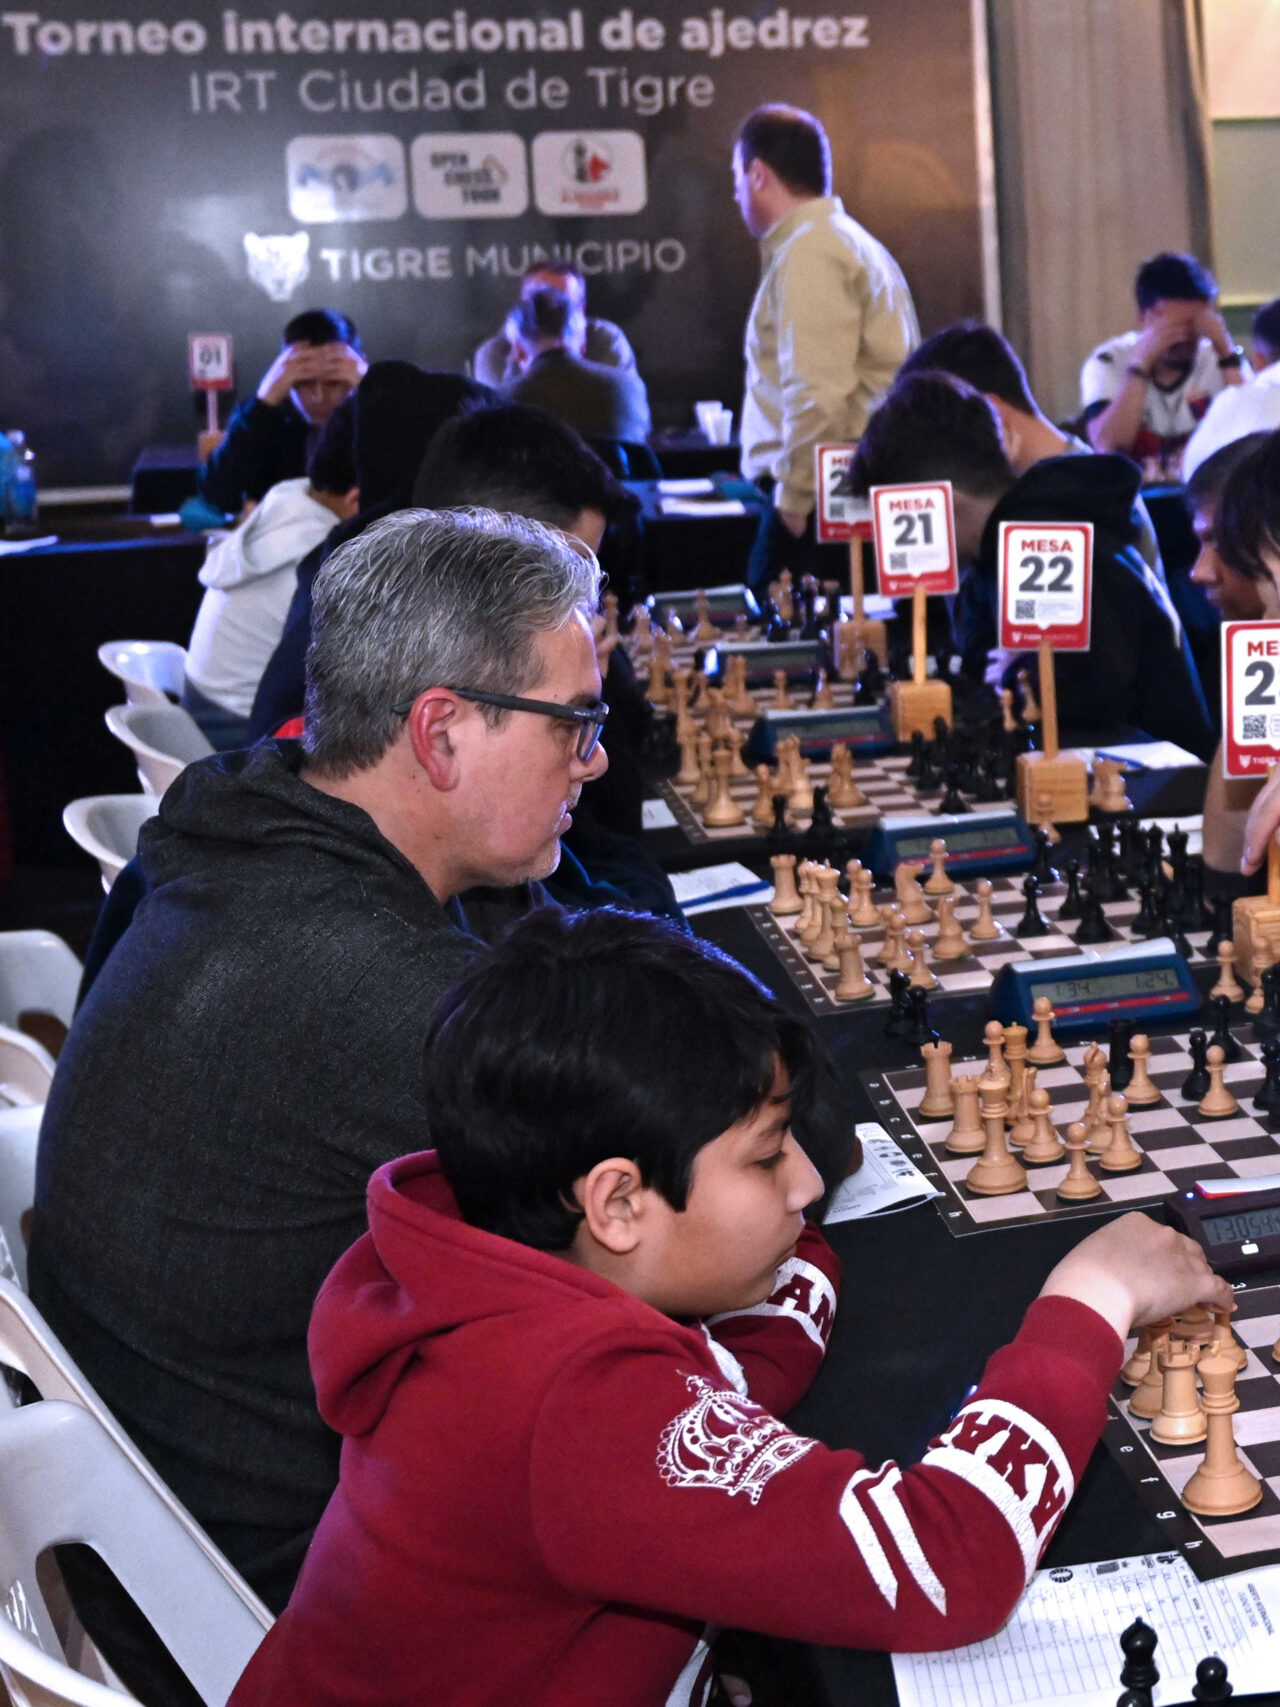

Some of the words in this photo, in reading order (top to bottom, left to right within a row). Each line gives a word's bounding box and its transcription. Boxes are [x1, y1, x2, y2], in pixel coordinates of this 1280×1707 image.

[2, 12, 207, 55] Torneo
[222, 8, 585, 53] internacional
[601, 9, 666, 50] de
[680, 8, 870, 58] ajedrez
[189, 70, 276, 112] IRT
[299, 68, 487, 112] Ciudad
[505, 68, 570, 108] de
[586, 66, 715, 115] Tigre
[320, 246, 453, 281] TIGRE
[465, 238, 687, 278] MUNICIPIO
[889, 497, 936, 512] MESA
[893, 512, 934, 547] 21
[1021, 539, 1073, 553] MESA
[1019, 555, 1074, 593] 22
